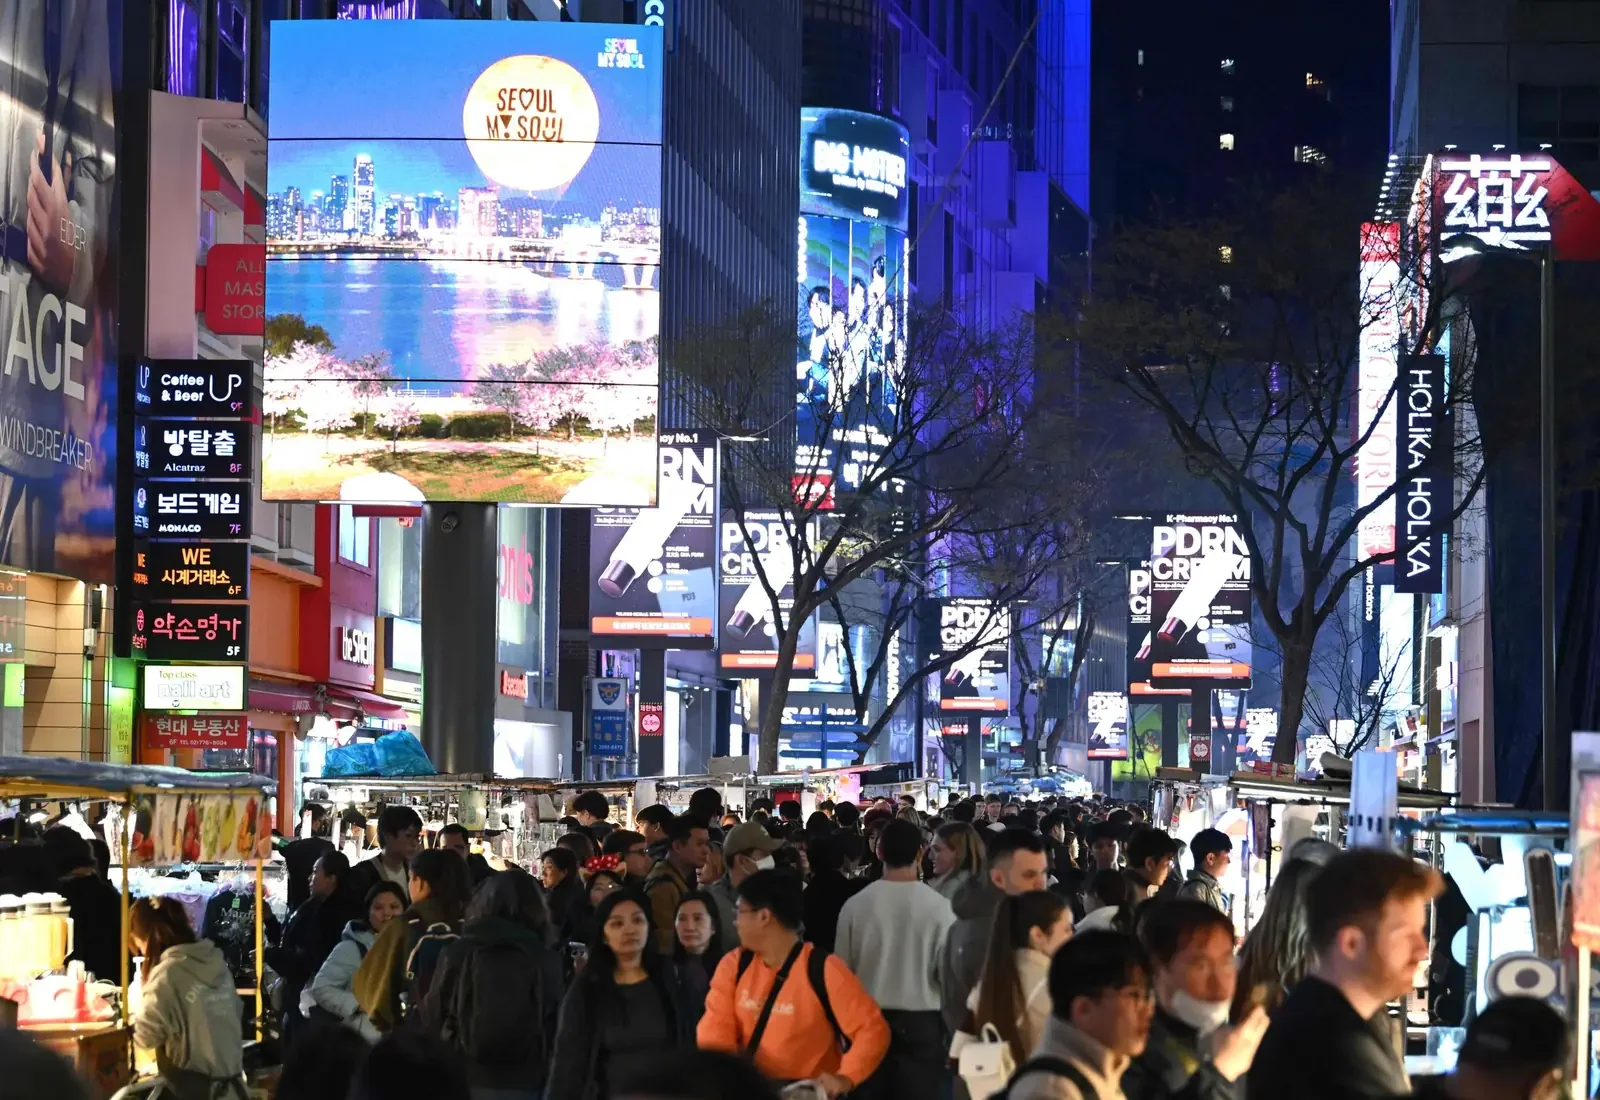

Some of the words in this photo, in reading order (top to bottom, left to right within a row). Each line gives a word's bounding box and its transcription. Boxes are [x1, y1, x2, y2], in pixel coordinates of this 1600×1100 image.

[605, 38, 638, 53] SEOUL
[497, 88, 556, 113] SEOUL
[518, 115, 564, 143] SOUL
[60, 217, 86, 252] EIDER
[236, 259, 264, 273] ALL
[0, 266, 86, 401] AGE
[161, 374, 204, 386] Coffee
[209, 374, 242, 402] UP
[161, 389, 171, 401] &
[175, 389, 204, 401] Beer
[230, 402, 243, 412] 9F
[1408, 369, 1433, 470] HOLIKA
[0, 415, 93, 472] WINDBREAKER
[164, 429, 236, 456] 방탈출
[164, 462, 206, 472] Alcatraz
[229, 463, 242, 474] 8F
[158, 493, 240, 514] 보드게임
[158, 524, 201, 533] MONACO
[229, 523, 241, 534] 7F
[1406, 477, 1432, 578] HOLIKA
[1153, 525, 1250, 556] PDRN
[182, 548, 211, 565] WE
[161, 569, 231, 585] 시계거래소
[227, 585, 242, 595] 6F
[152, 612, 242, 641] 약손명가
[226, 646, 241, 656] 5F
[158, 681, 196, 698] nail
[199, 681, 231, 698] art
[156, 719, 188, 736] 현대
[192, 719, 240, 737] 부동산
